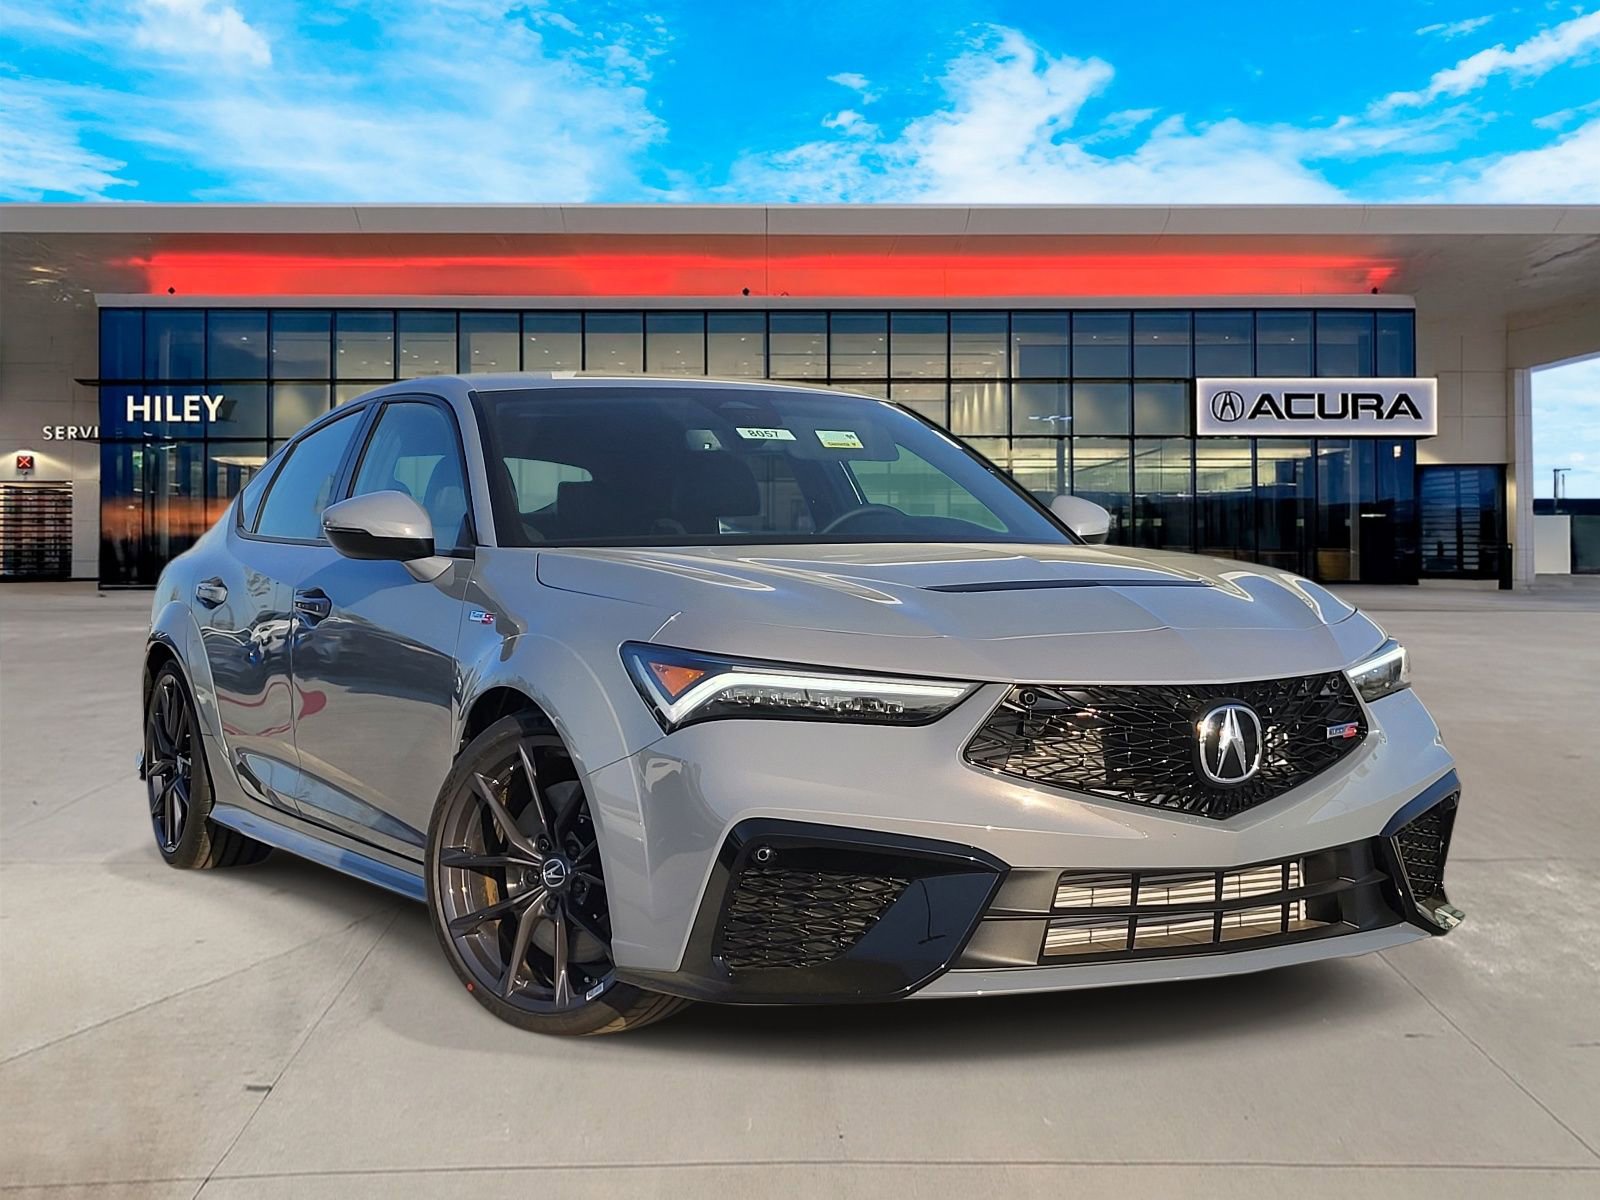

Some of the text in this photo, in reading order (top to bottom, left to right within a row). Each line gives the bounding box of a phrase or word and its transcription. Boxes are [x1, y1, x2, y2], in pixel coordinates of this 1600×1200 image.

[126, 395, 224, 422] HILEY
[1248, 393, 1422, 420] ACURA
[42, 426, 99, 441] SERVI
[747, 430, 779, 438] 8057
